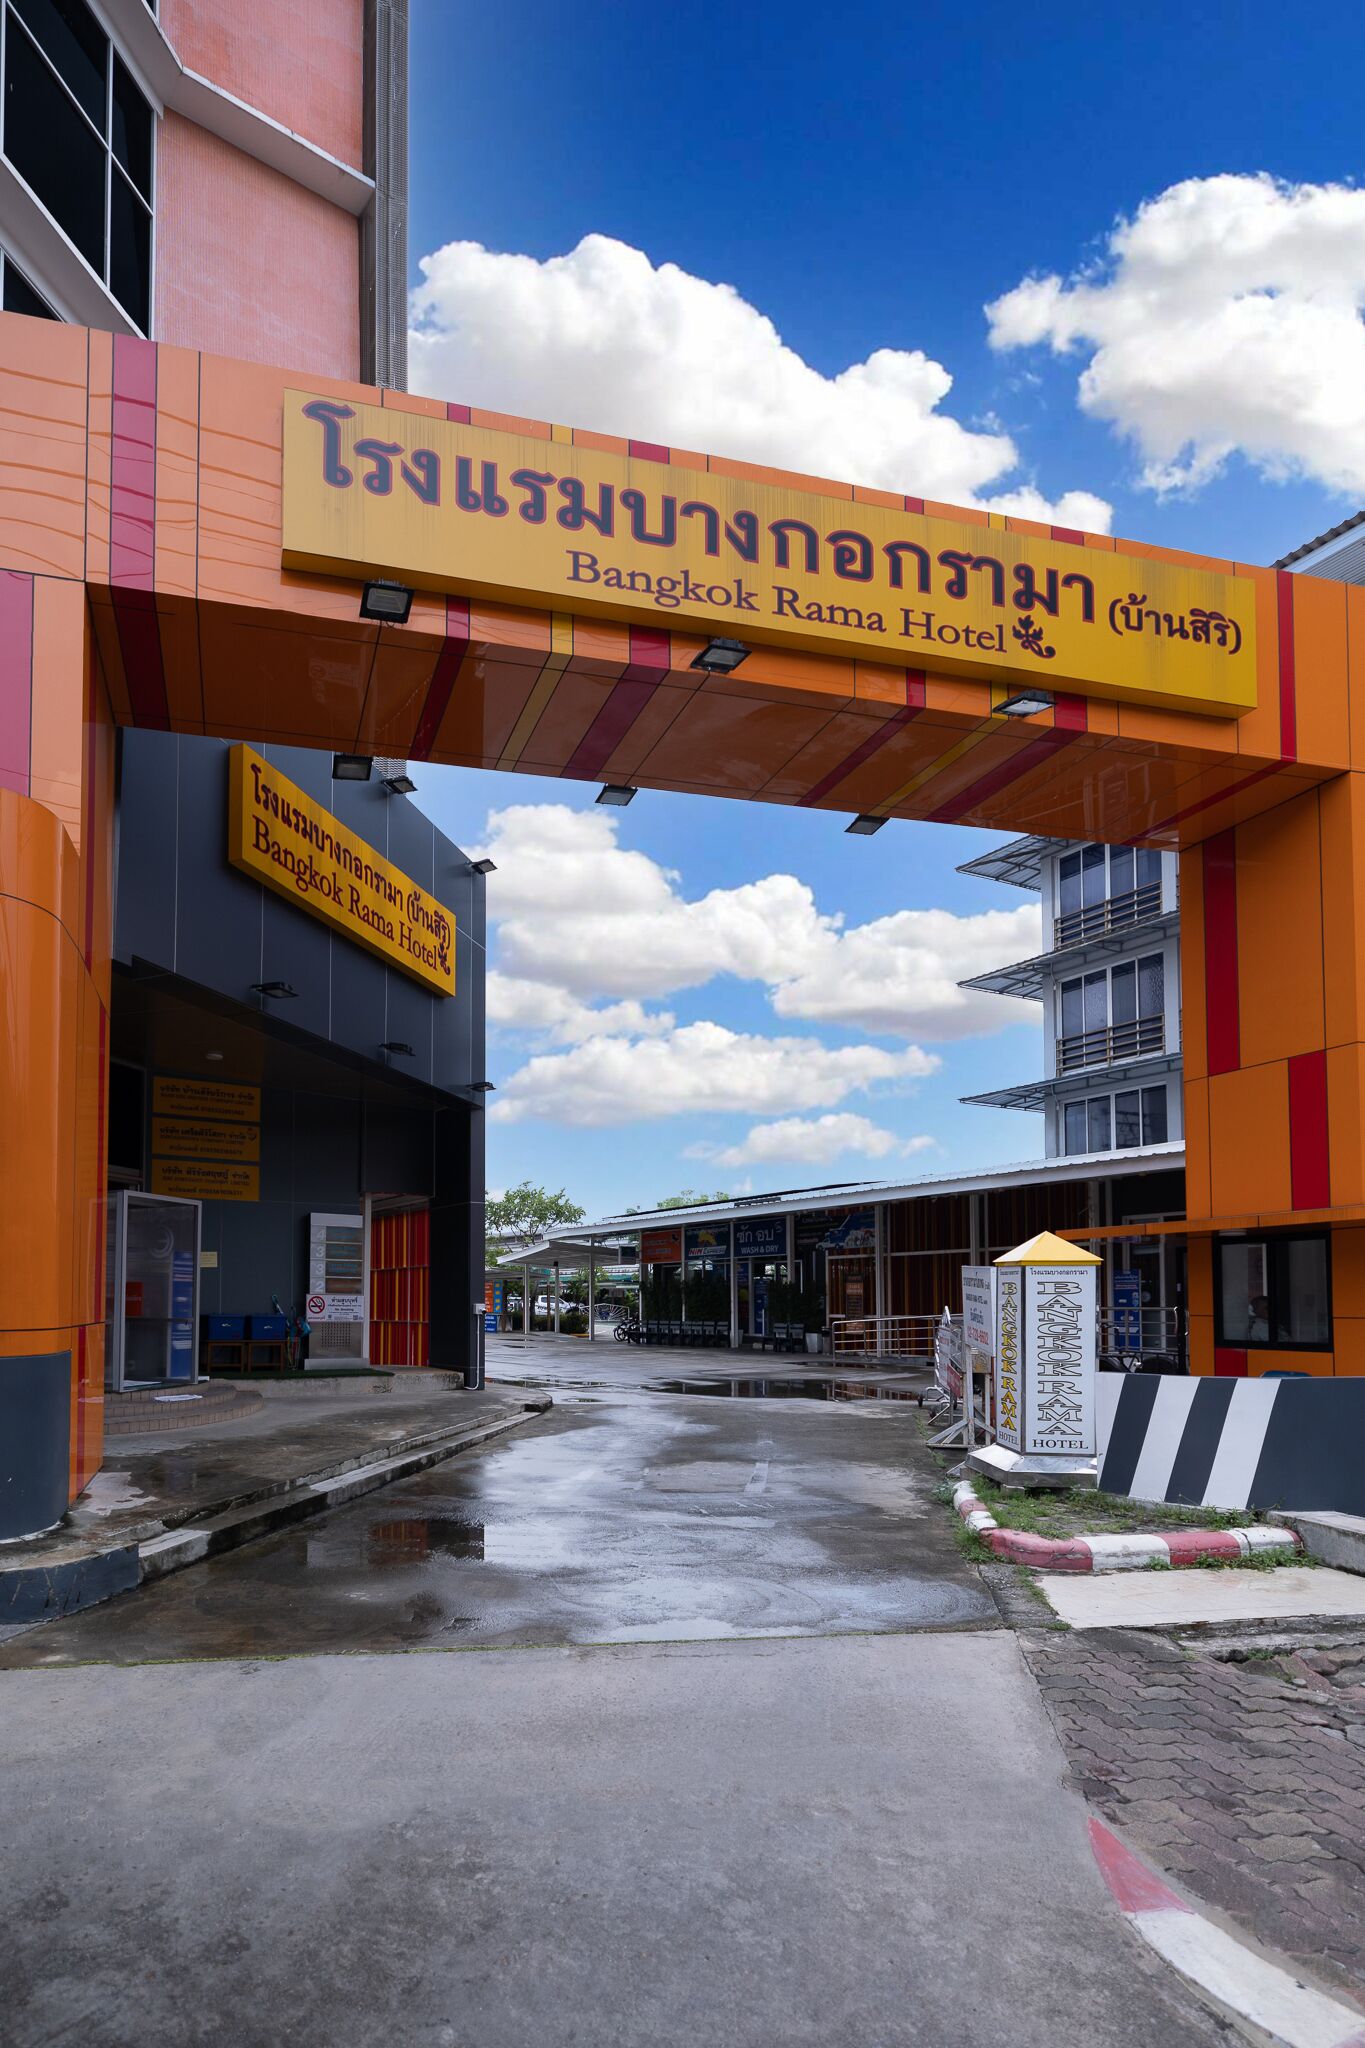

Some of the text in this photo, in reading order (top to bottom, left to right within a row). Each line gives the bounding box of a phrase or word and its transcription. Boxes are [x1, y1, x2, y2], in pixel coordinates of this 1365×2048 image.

[302, 400, 1243, 655] โรงแรมบางกอกรามา (บ้านสิริ)
[565, 550, 1008, 653] Bangkok Rama Hotel
[250, 763, 451, 950] โรงแรมบางกอกรามา (บ้านสิริ)
[252, 815, 438, 971] Bangkok Rama Hotel
[741, 1245, 759, 1254] WASH
[765, 1244, 779, 1253] DRY
[1030, 1267, 1088, 1276] โรงแรมบางกอกรามา
[1001, 1281, 1018, 1374] BANGKOK
[1037, 1281, 1082, 1435] BANGKOK RAMA
[998, 1431, 1020, 1446] HOTEL
[1001, 1375, 1018, 1432] RAMA
[1032, 1438, 1088, 1449] HOTEL
